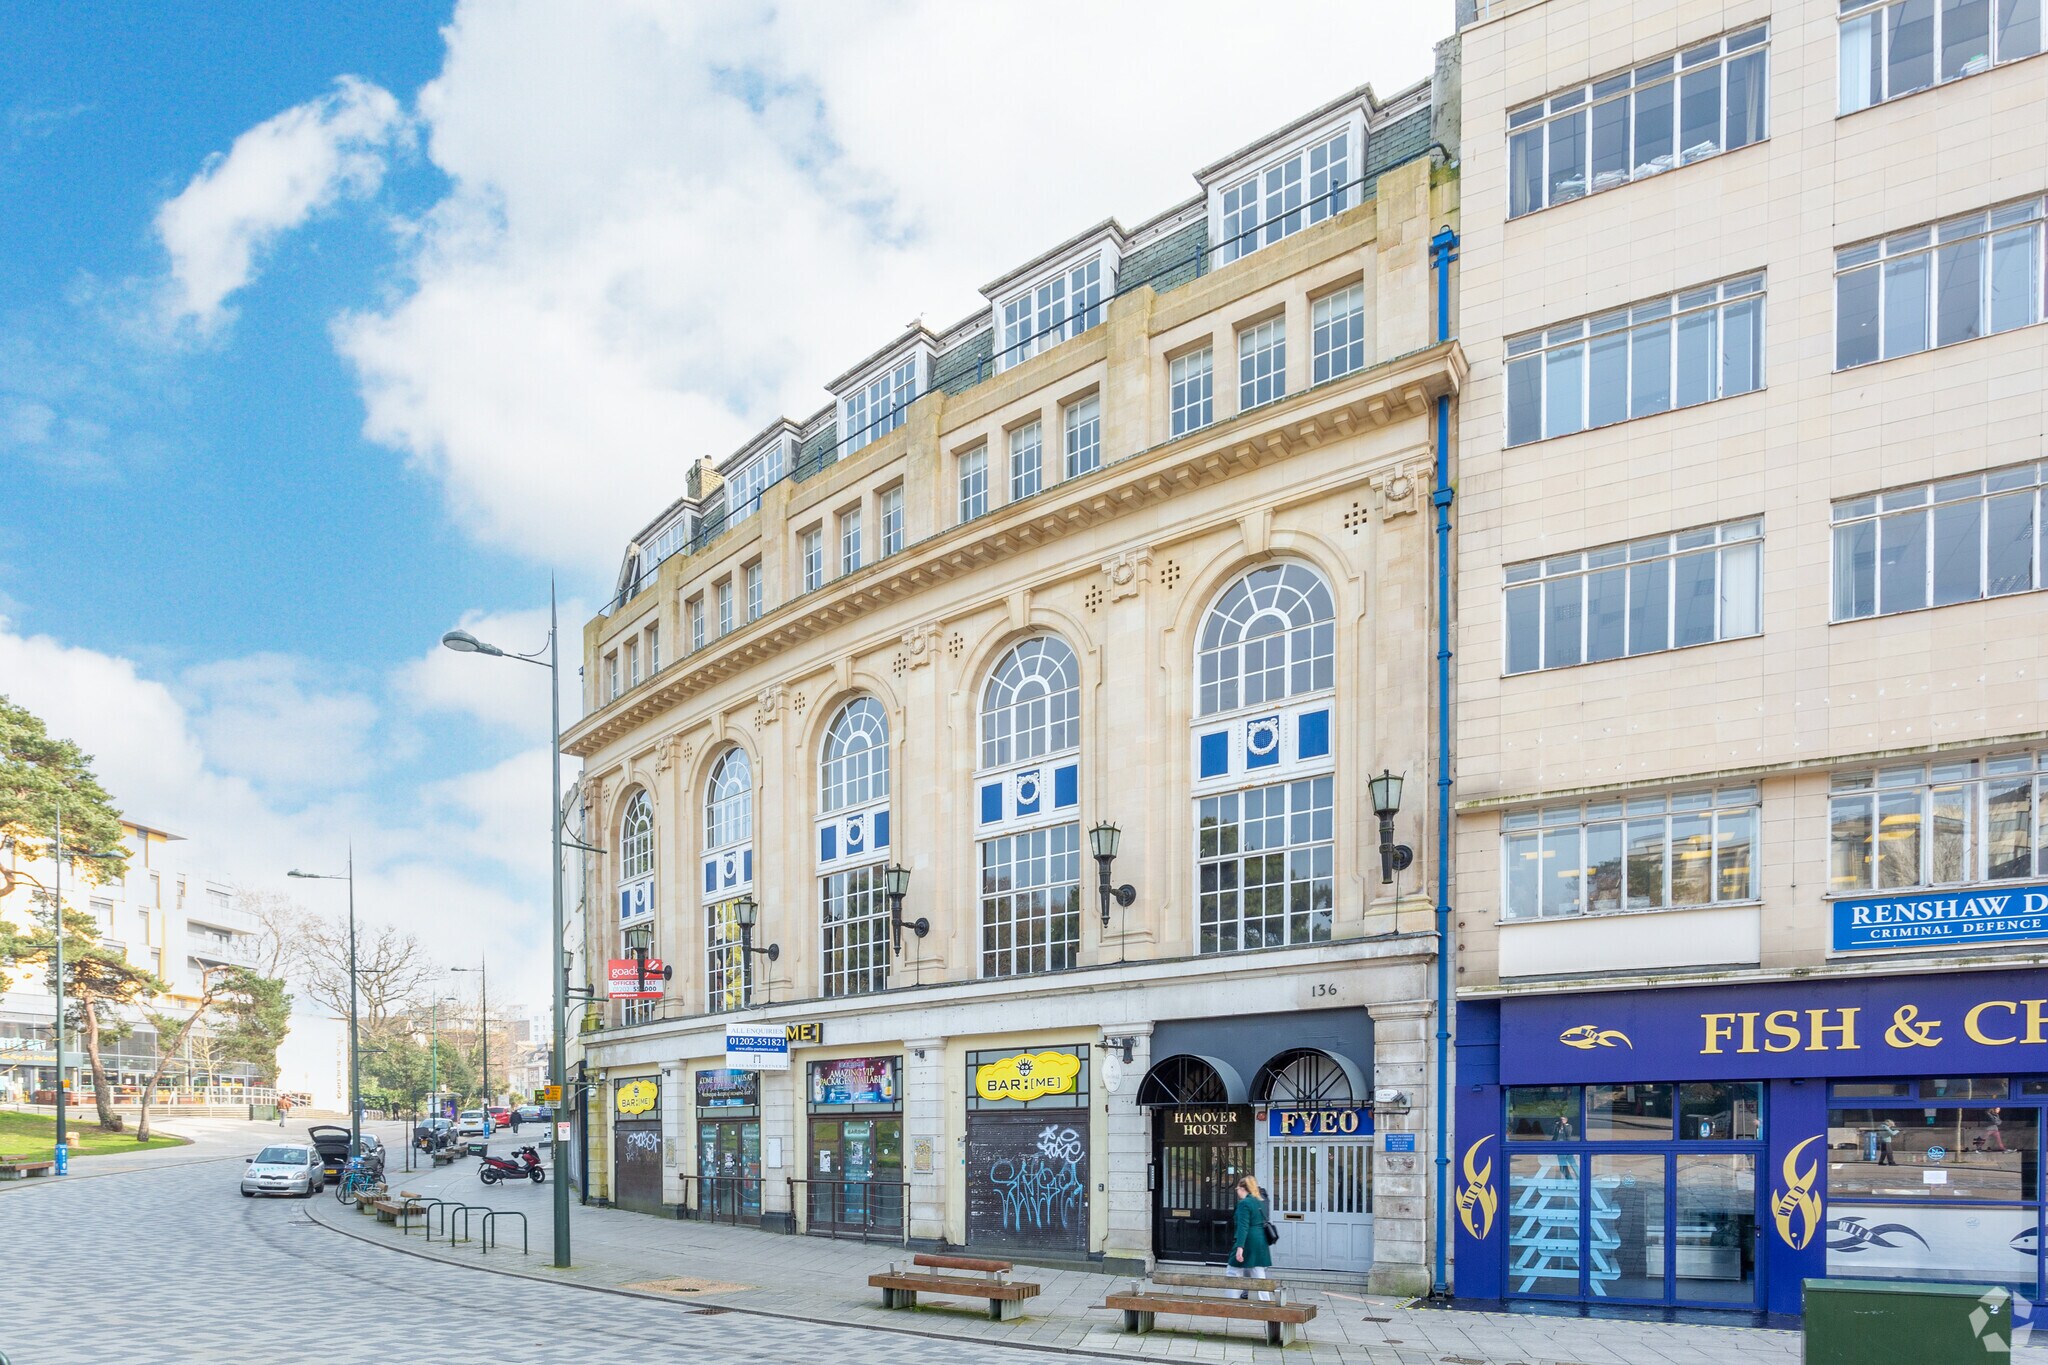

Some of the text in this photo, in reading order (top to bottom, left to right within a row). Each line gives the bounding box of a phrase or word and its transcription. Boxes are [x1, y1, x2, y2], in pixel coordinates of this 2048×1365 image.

[1852, 895, 2012, 925] RENSHAW
[1870, 918, 2042, 939] CRIMINAL DEFENCE
[1312, 983, 1338, 997] 136
[1580, 1028, 1601, 1042] WILD
[1700, 1007, 1861, 1053] FISH
[1884, 1004, 1943, 1048] &
[729, 1037, 785, 1047] 01202-551821
[829, 1066, 875, 1079] AMAZING VIP
[1174, 1111, 1237, 1124] HANOVER
[1280, 1110, 1359, 1134] FYEO
[1183, 1124, 1228, 1136] HOUSE
[1461, 1181, 1483, 1210] WILD
[1778, 1186, 1805, 1217] WILD
[1838, 1221, 1873, 1241] WILD
[1989, 1304, 1999, 1314] 2
